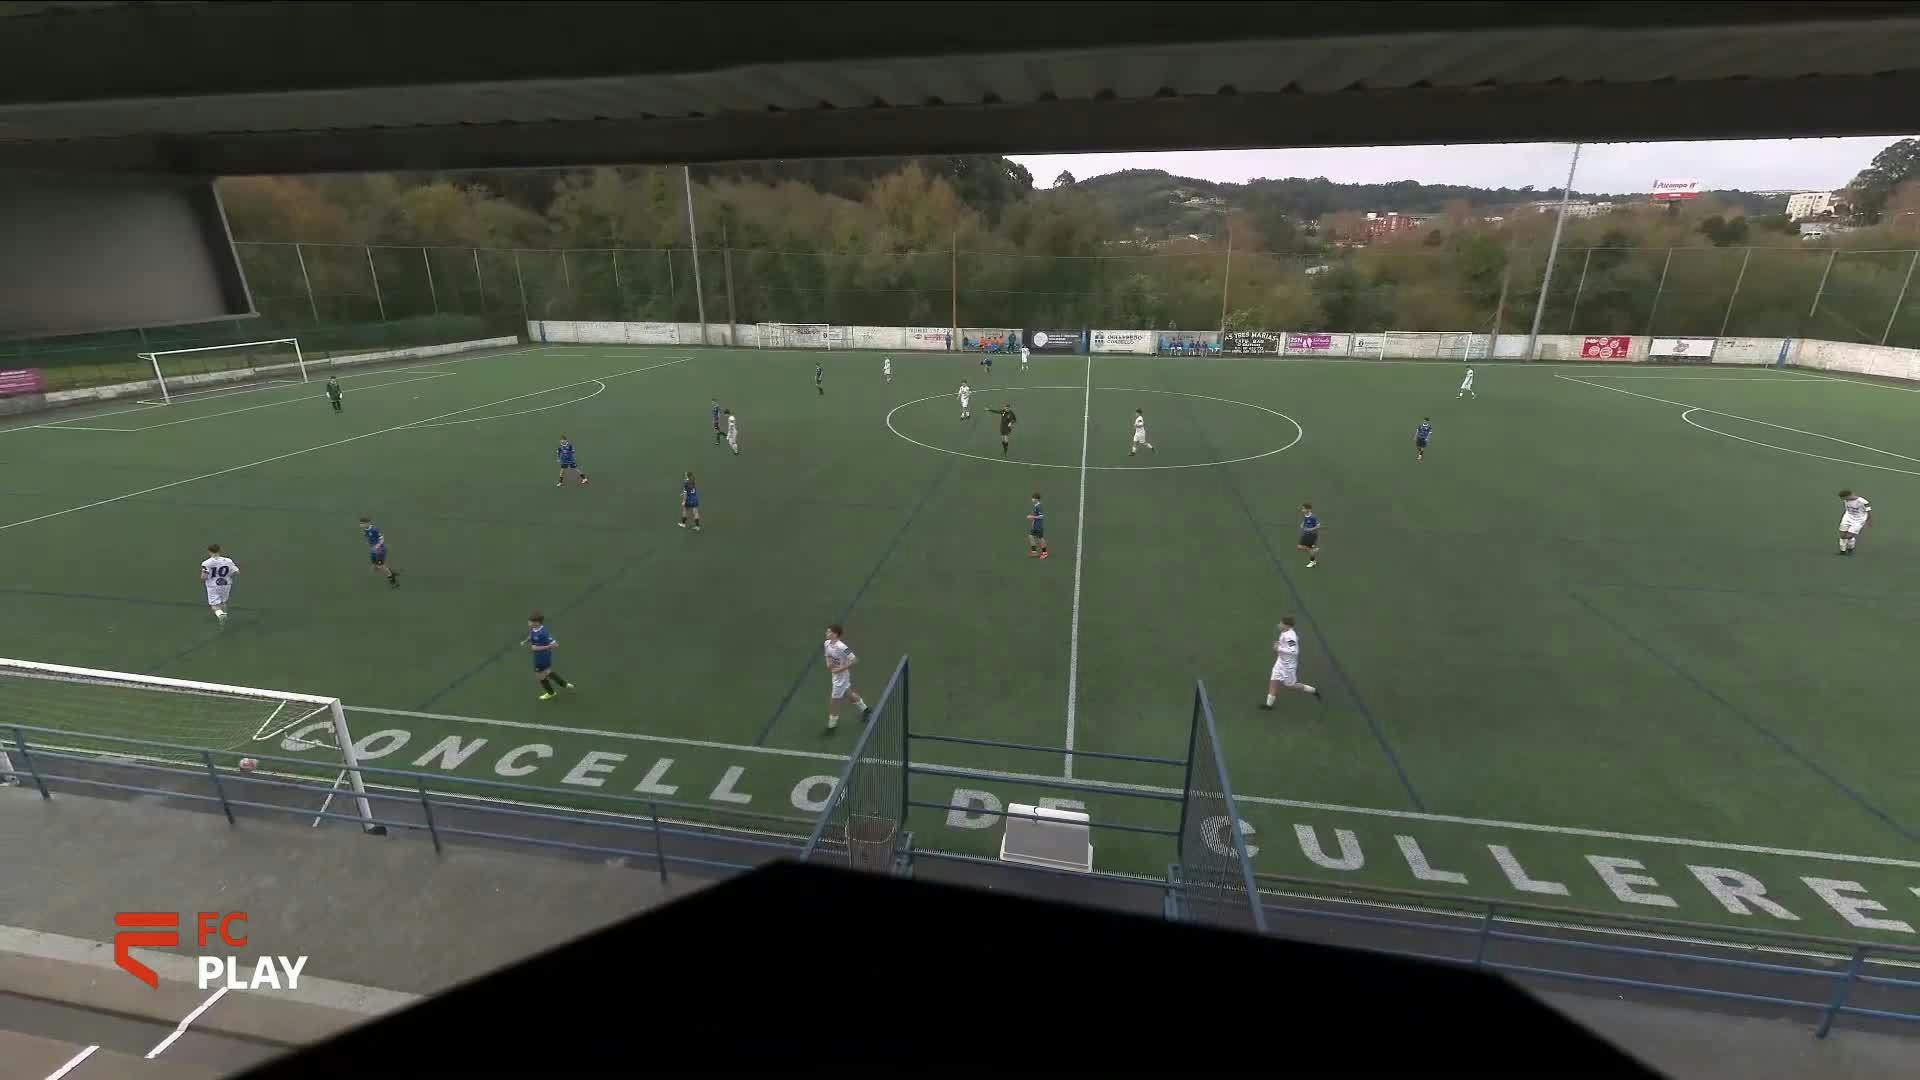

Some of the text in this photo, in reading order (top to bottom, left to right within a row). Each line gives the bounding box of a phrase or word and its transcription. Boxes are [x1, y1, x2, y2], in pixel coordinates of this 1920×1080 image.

[1234, 331, 1250, 339] TRES
[1251, 331, 1277, 342] MARIAS
[210, 565, 230, 578] 10
[280, 721, 848, 812] CONCELLO
